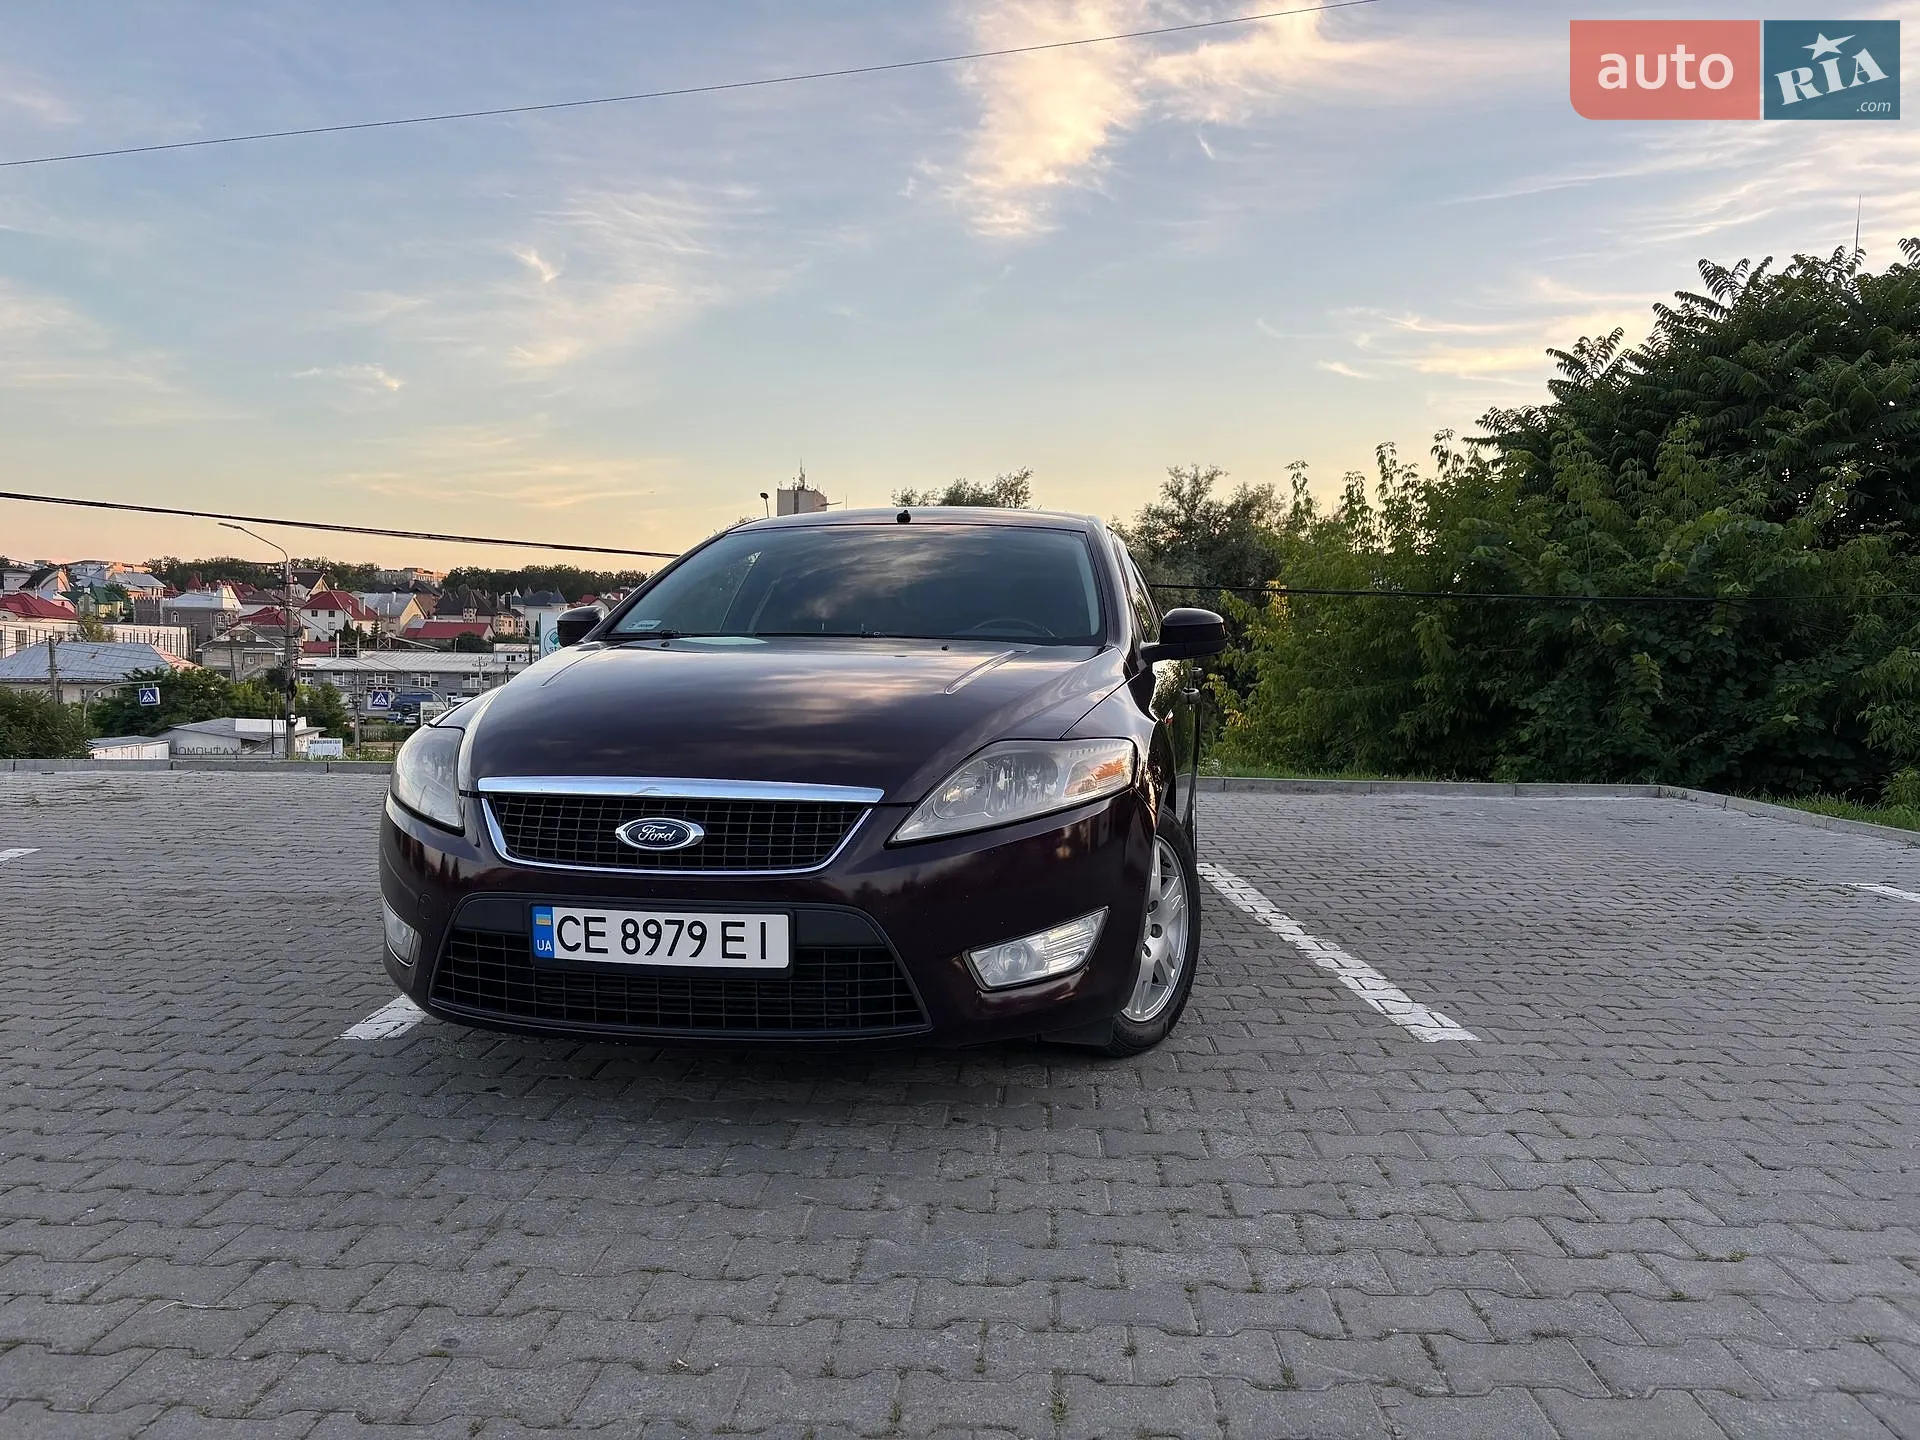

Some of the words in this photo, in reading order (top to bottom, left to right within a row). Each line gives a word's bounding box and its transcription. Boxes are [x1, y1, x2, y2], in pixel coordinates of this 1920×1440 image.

[638, 824, 677, 842] Ford
[537, 939, 553, 952] UA
[556, 915, 609, 954] CE
[620, 918, 708, 958] 8979
[720, 920, 767, 960] EI
